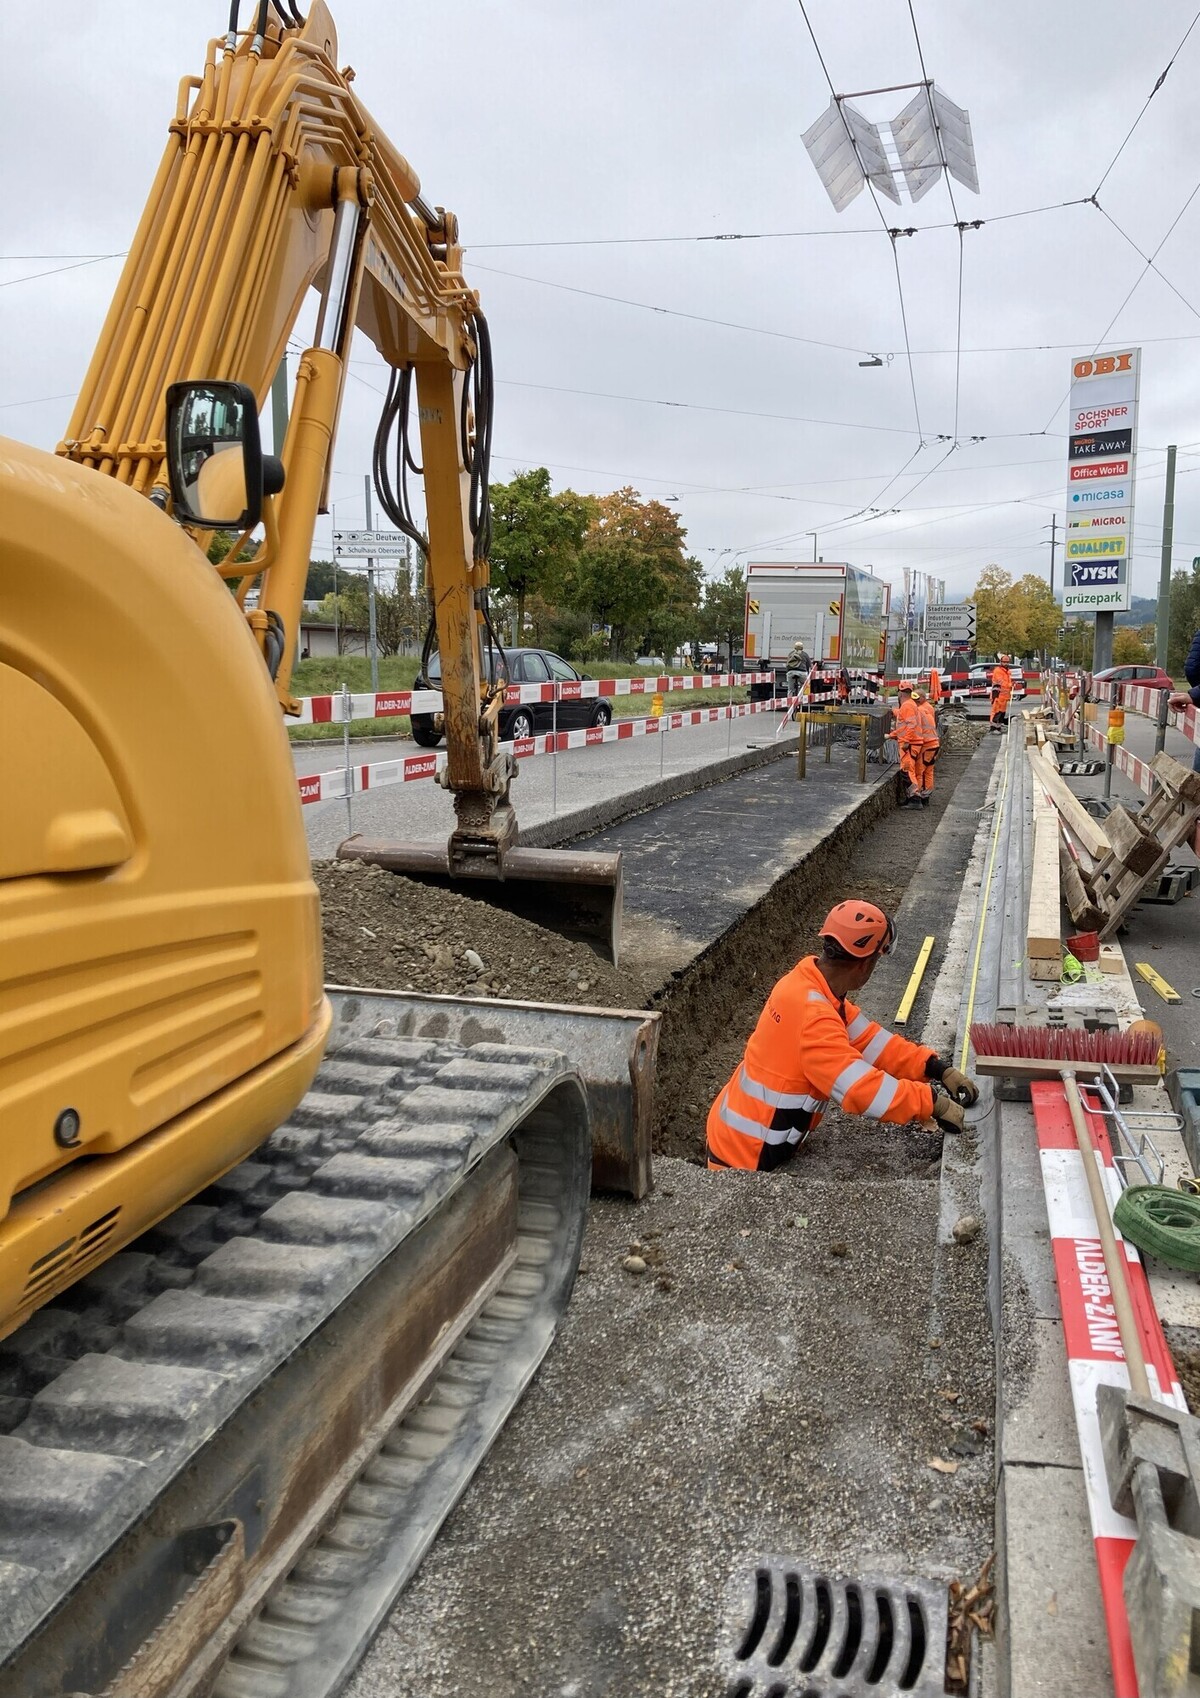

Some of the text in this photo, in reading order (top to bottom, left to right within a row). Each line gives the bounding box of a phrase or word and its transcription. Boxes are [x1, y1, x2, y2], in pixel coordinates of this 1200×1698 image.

[1074, 354, 1132, 378] OBI
[1078, 407, 1128, 421] OCHSNER
[1075, 419, 1109, 431] SPORT
[1074, 440, 1127, 454] TAKE AWAY
[1073, 464, 1125, 479] Office World
[1081, 489, 1124, 502] micasa
[1091, 516, 1126, 527] MIGROL
[376, 533, 406, 543] Deutweg
[348, 546, 405, 554] Schulhaus Oberseen
[1069, 541, 1122, 555] QUALIPET
[1080, 565, 1119, 581] JYSK
[1065, 591, 1122, 607] grüzepark
[1074, 1239, 1125, 1352] ALDER-ZANI
